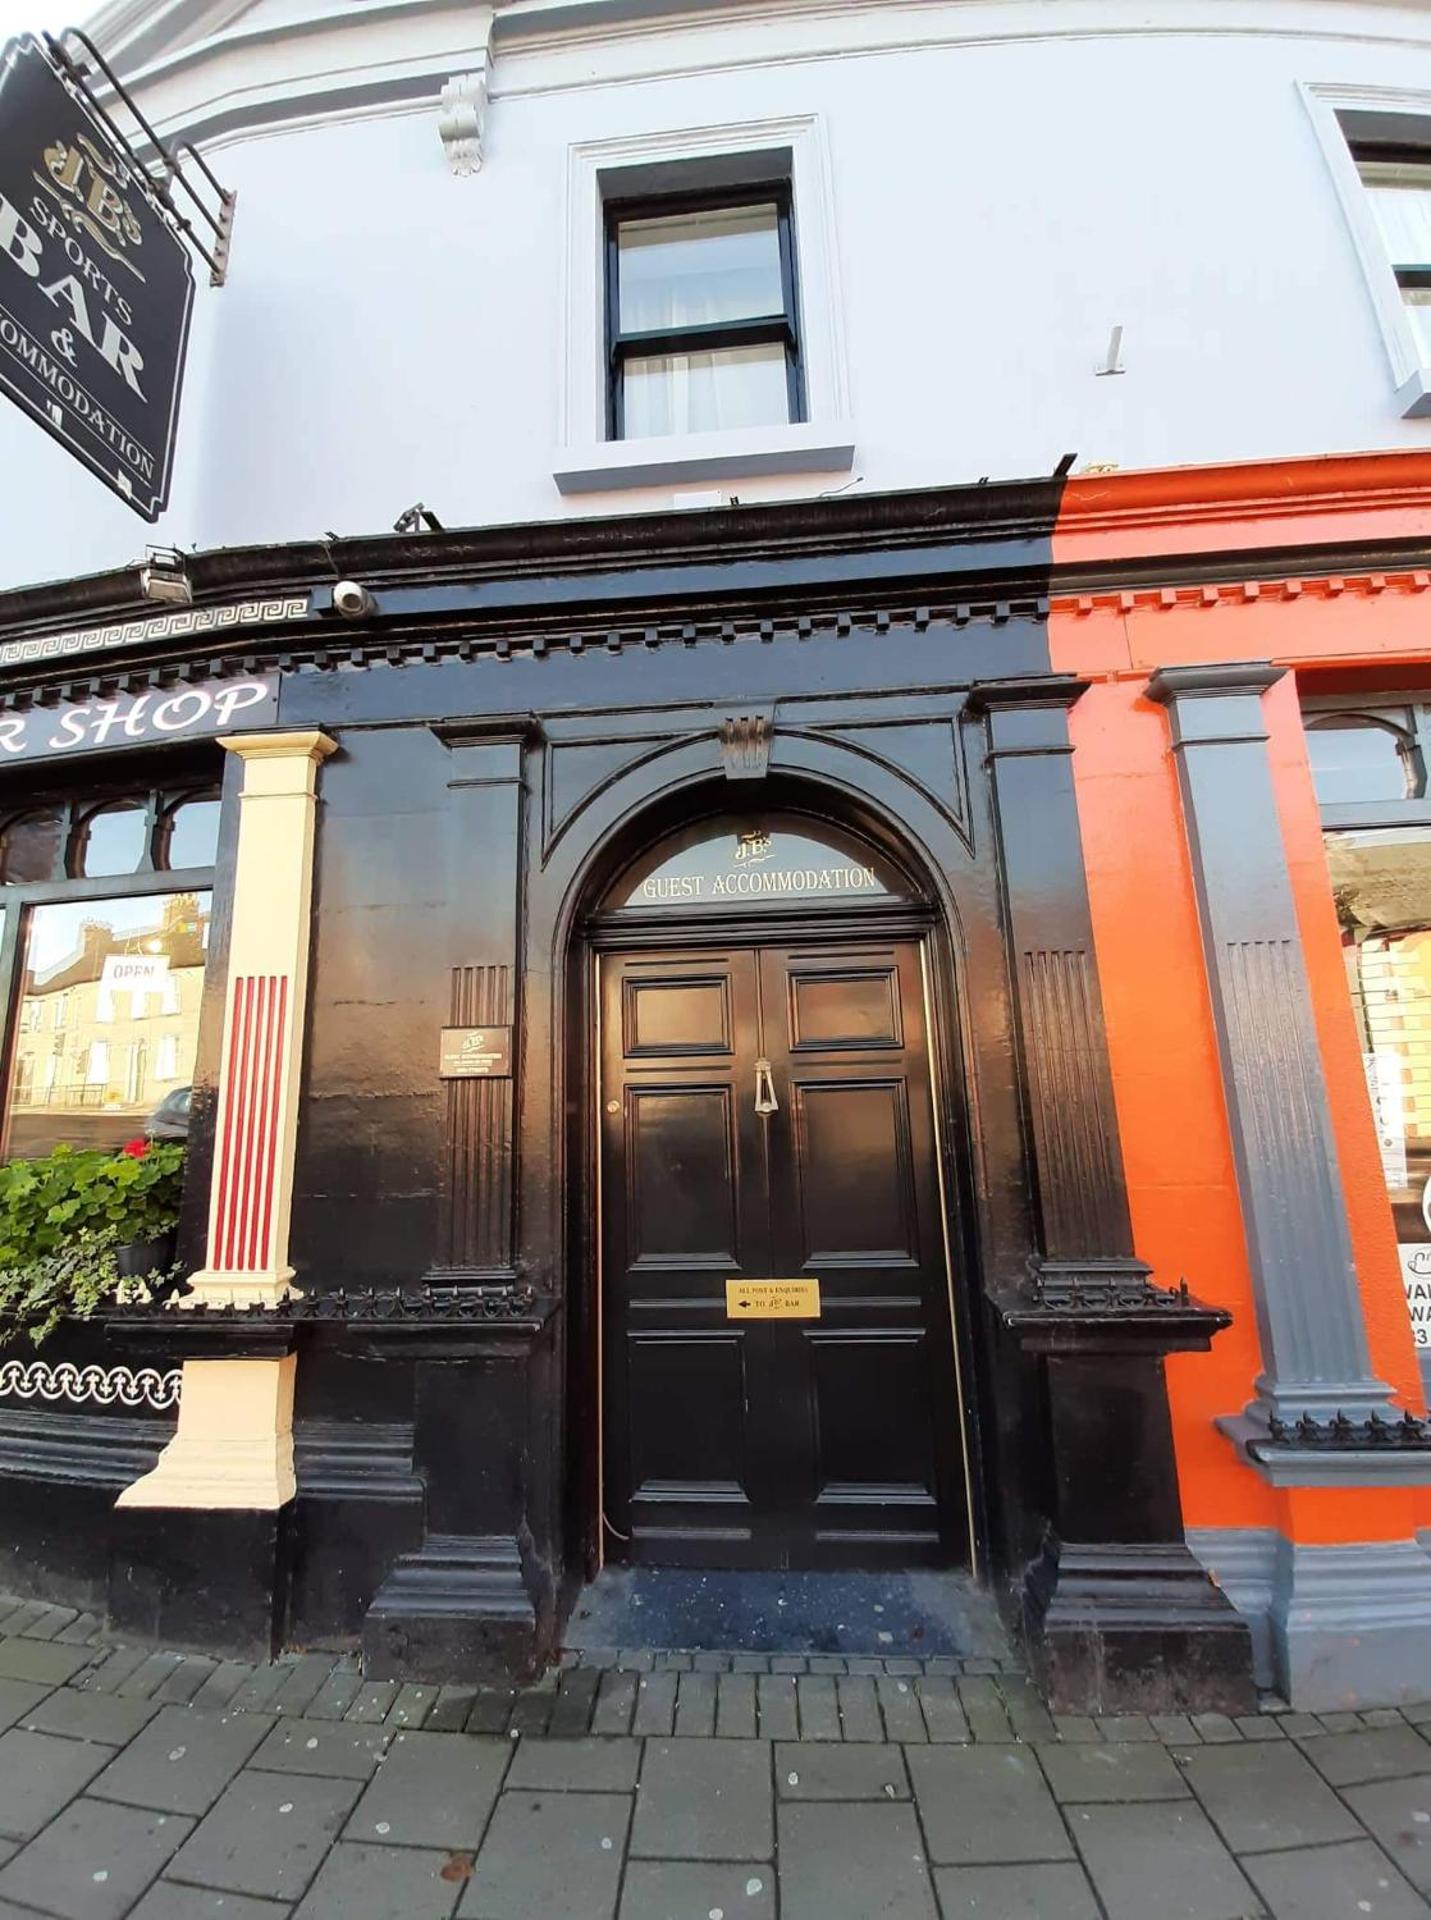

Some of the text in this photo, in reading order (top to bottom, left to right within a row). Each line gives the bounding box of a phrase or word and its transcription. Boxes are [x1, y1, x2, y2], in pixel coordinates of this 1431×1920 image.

[29, 196, 133, 326] SPORTS
[0, 193, 148, 403] BAR
[51, 328, 78, 368] &
[0, 314, 154, 479] OMMODATION
[49, 683, 268, 749] SHOP
[643, 867, 876, 898] GUEST ACCOMMODATION
[113, 964, 155, 979] OPEN
[785, 1300, 800, 1308] BAR
